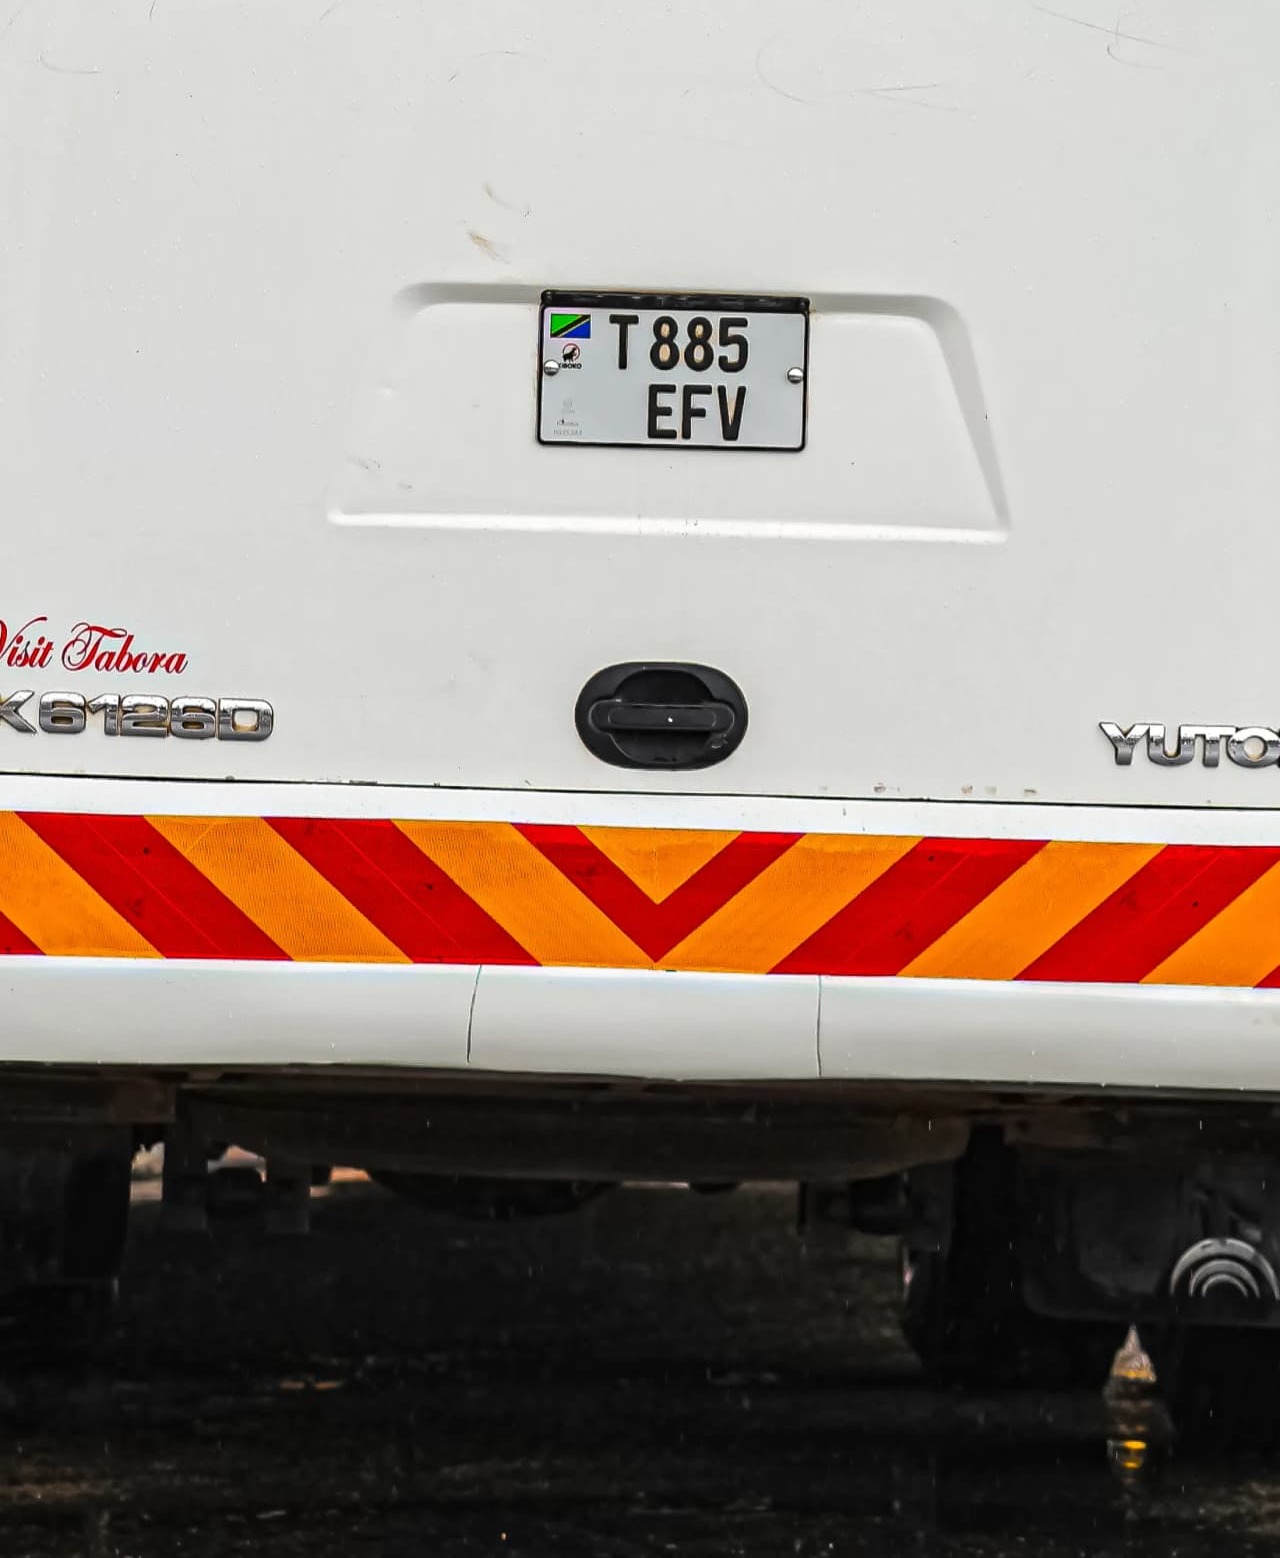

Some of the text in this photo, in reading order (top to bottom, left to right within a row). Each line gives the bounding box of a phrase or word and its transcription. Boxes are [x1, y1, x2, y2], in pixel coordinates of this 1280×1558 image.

[608, 313, 749, 373] T 885
[647, 383, 747, 442] EFV
[61, 622, 189, 675] Tabora
